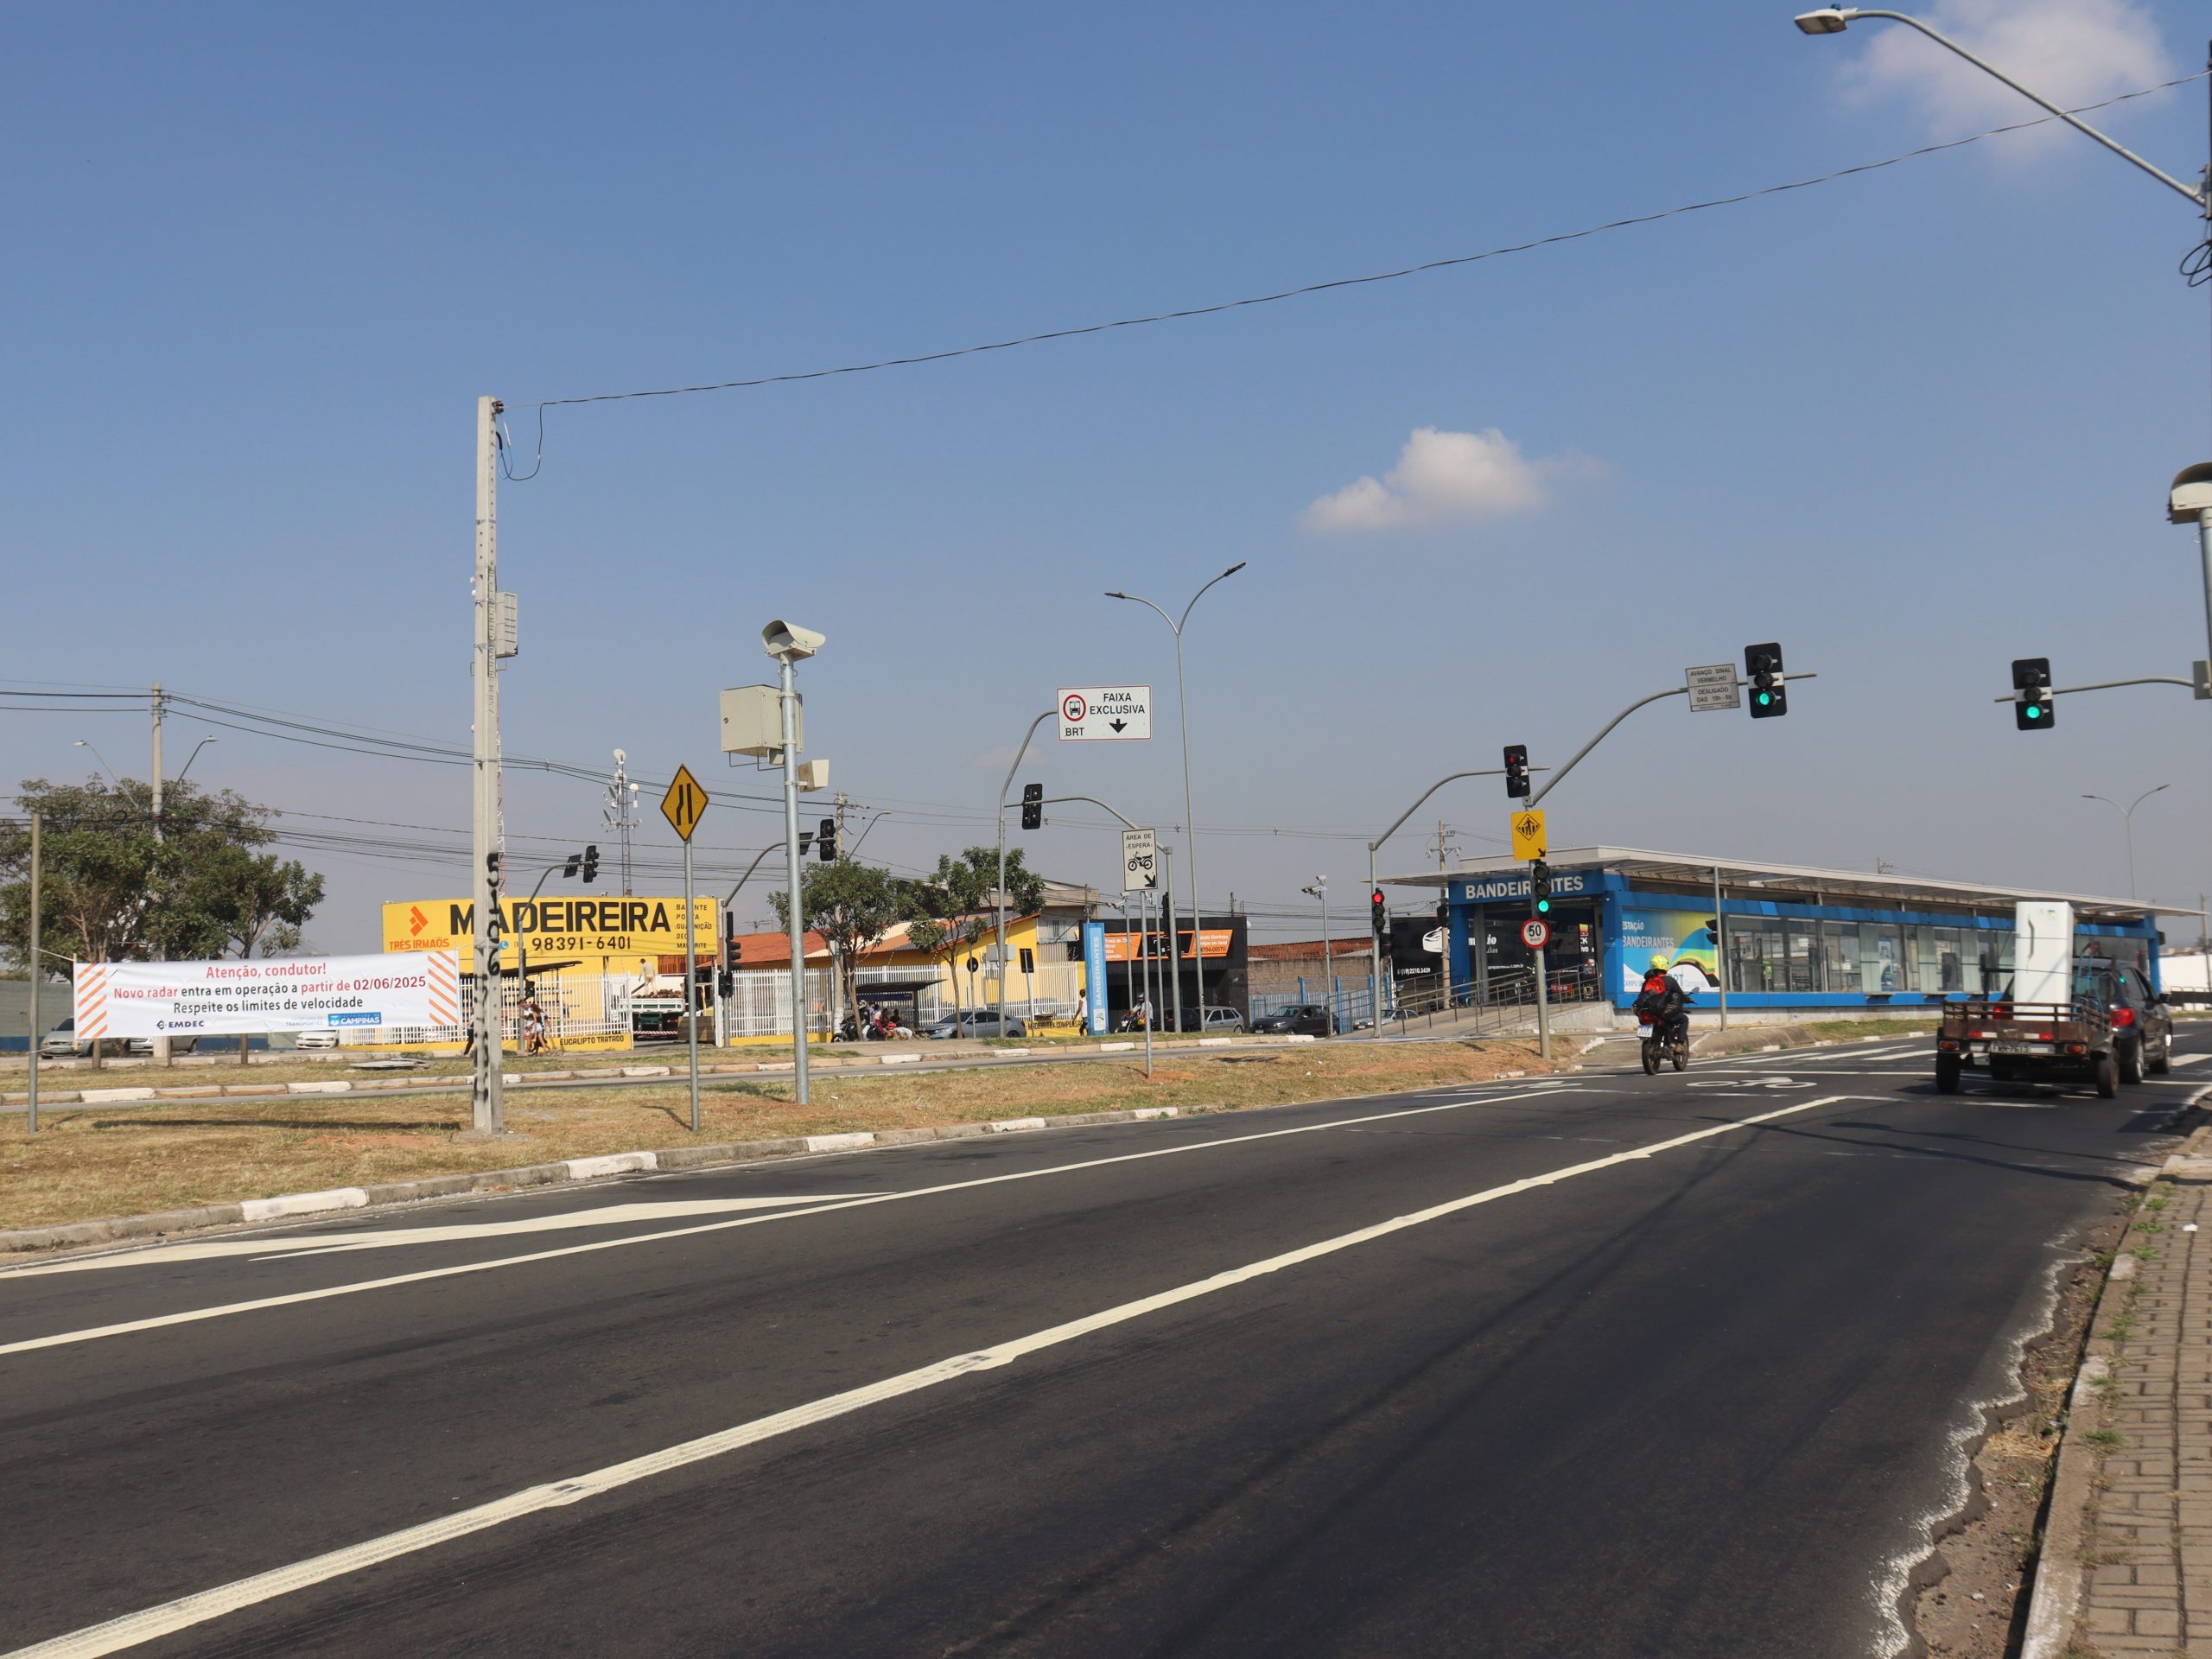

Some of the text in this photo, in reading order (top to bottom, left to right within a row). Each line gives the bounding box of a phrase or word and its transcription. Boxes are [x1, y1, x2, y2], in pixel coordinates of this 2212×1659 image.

[1103, 693, 1132, 702] FAIXA
[1090, 704, 1146, 715] EXCLUSIVA
[1065, 728, 1084, 737] BRT
[1465, 875, 1584, 899] BANDEIRNTES
[676, 921, 713, 931] GUNIÇÃO
[1529, 925, 1541, 937] 50
[1622, 919, 1644, 933] ESTAÇÃO
[531, 936, 632, 951] 98391-6401
[207, 963, 327, 981] Atenção, condutor!
[1093, 936, 1103, 1007] BANDEIRANTES
[114, 976, 427, 999] Novo radar entra em operação a partir de 02/06/2025
[174, 995, 364, 1015] Respeite os limites de velocidade
[340, 1016, 380, 1025] CAMPINAS
[560, 1035, 625, 1046] EUCALIPTO TRATADO
